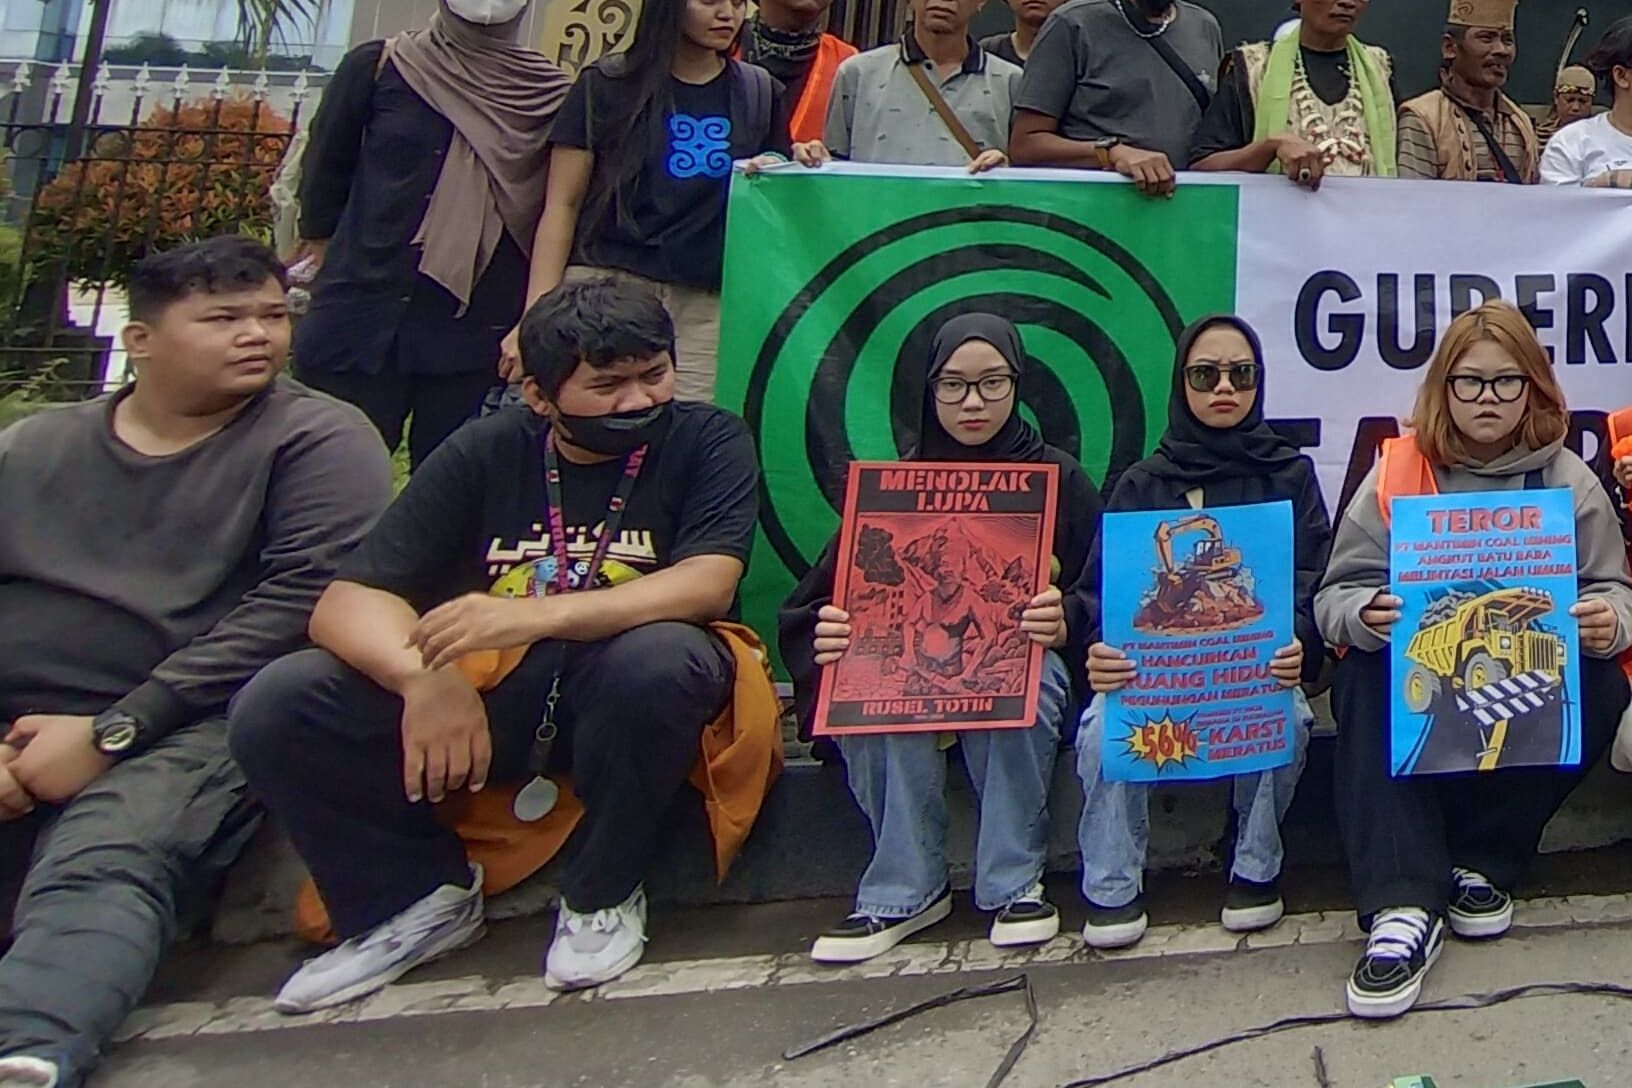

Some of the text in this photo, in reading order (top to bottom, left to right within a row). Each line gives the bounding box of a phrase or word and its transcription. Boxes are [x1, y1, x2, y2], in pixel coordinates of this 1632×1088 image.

[879, 470, 1032, 492] MENOLAK
[916, 492, 990, 512] LUPA
[1426, 506, 1542, 535] TEROR
[1485, 537, 1519, 548] COAL
[1418, 550, 1552, 565] ANGKUT BATU BARA
[1398, 564, 1573, 583] MELINTASI JALAN UMUM
[1200, 637, 1230, 648] COAL
[1141, 646, 1257, 667] HANCURKAN
[1212, 663, 1272, 684] HIDU
[862, 697, 992, 716] RUSEL TOTIN
[1141, 721, 1197, 760] 56%
[1208, 717, 1287, 745] KARST
[1208, 739, 1286, 761] MERATUS
